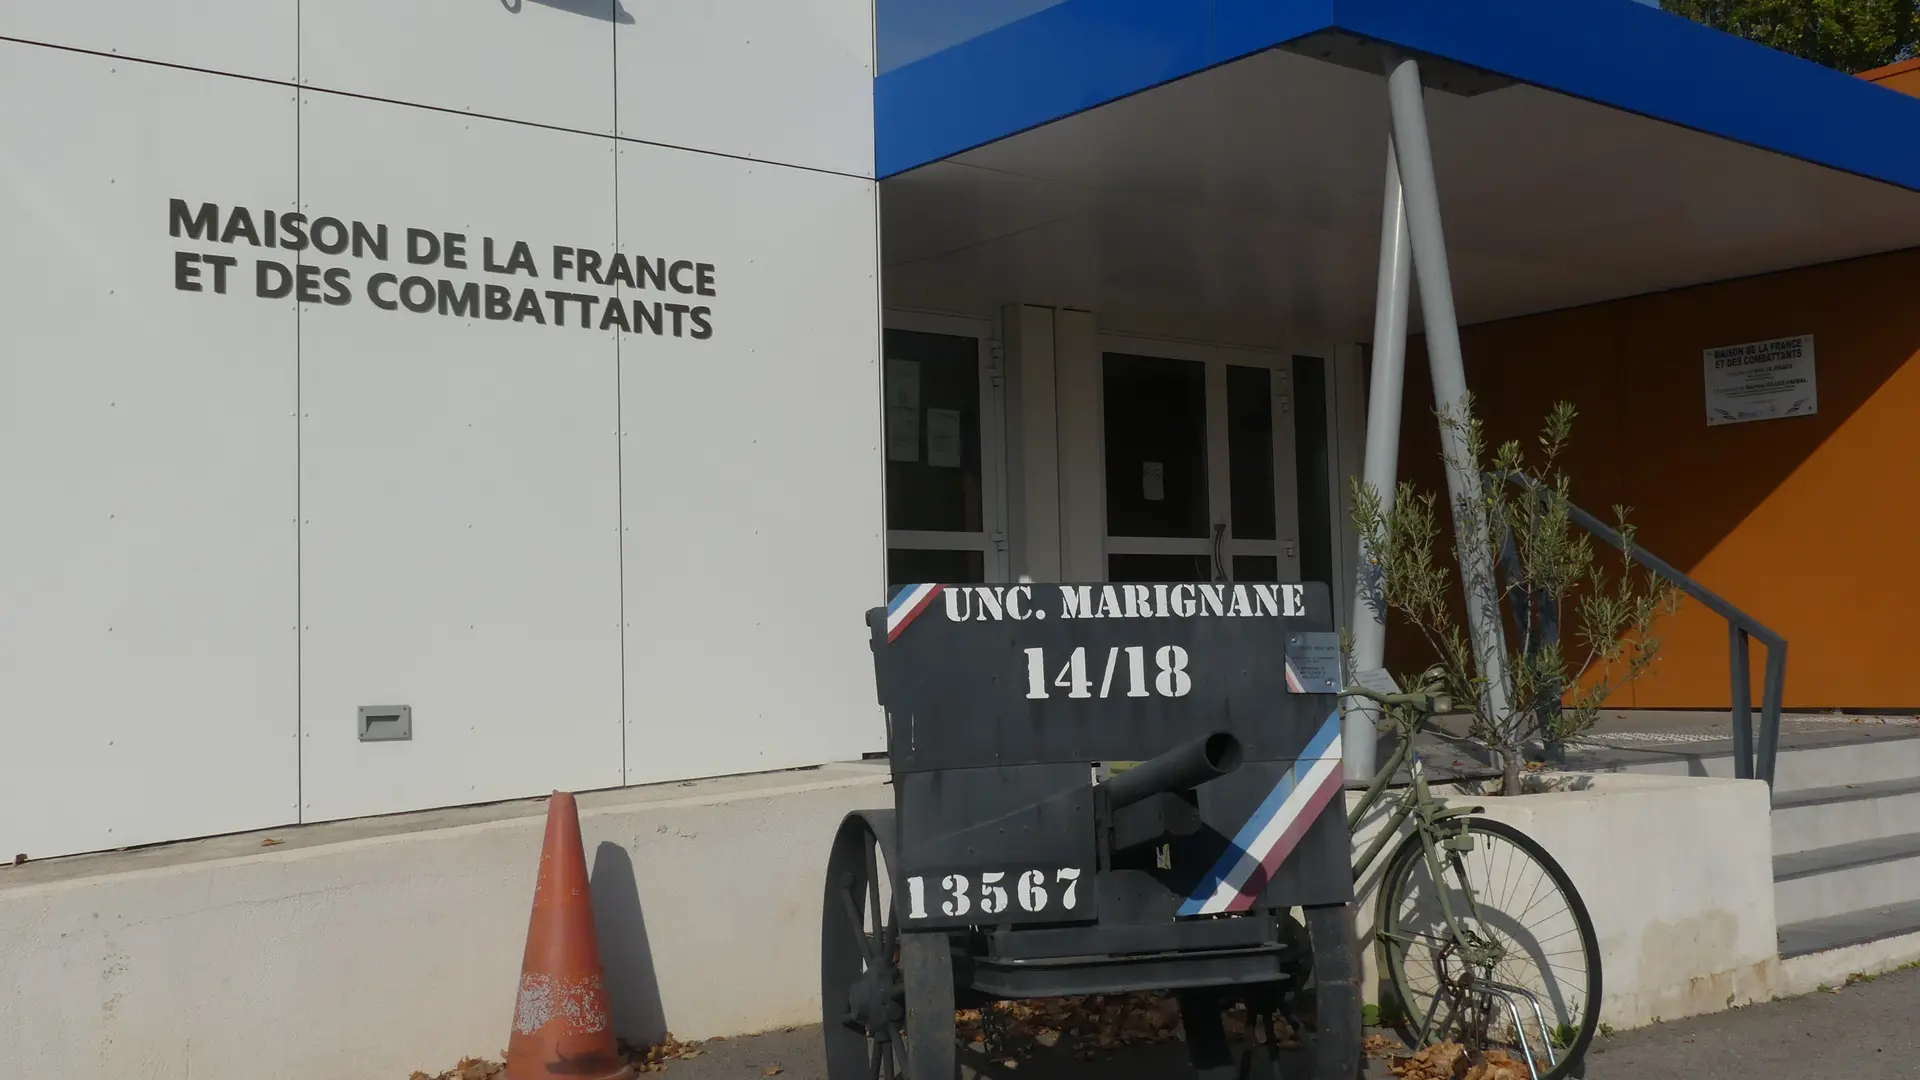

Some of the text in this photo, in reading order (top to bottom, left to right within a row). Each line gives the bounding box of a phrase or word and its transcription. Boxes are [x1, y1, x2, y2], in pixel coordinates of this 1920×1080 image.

[169, 198, 717, 297] MAISON DE LA FRANCE
[174, 252, 713, 340] ET DES COMBATTANTS
[1713, 339, 1802, 359] MAISON DE LA FRANCE
[1715, 349, 1802, 369] ET DES COMBATTANTS
[943, 584, 1305, 622] UNC. MARIGNANE
[1024, 645, 1192, 699] 14/18
[908, 867, 1081, 919] 13567
